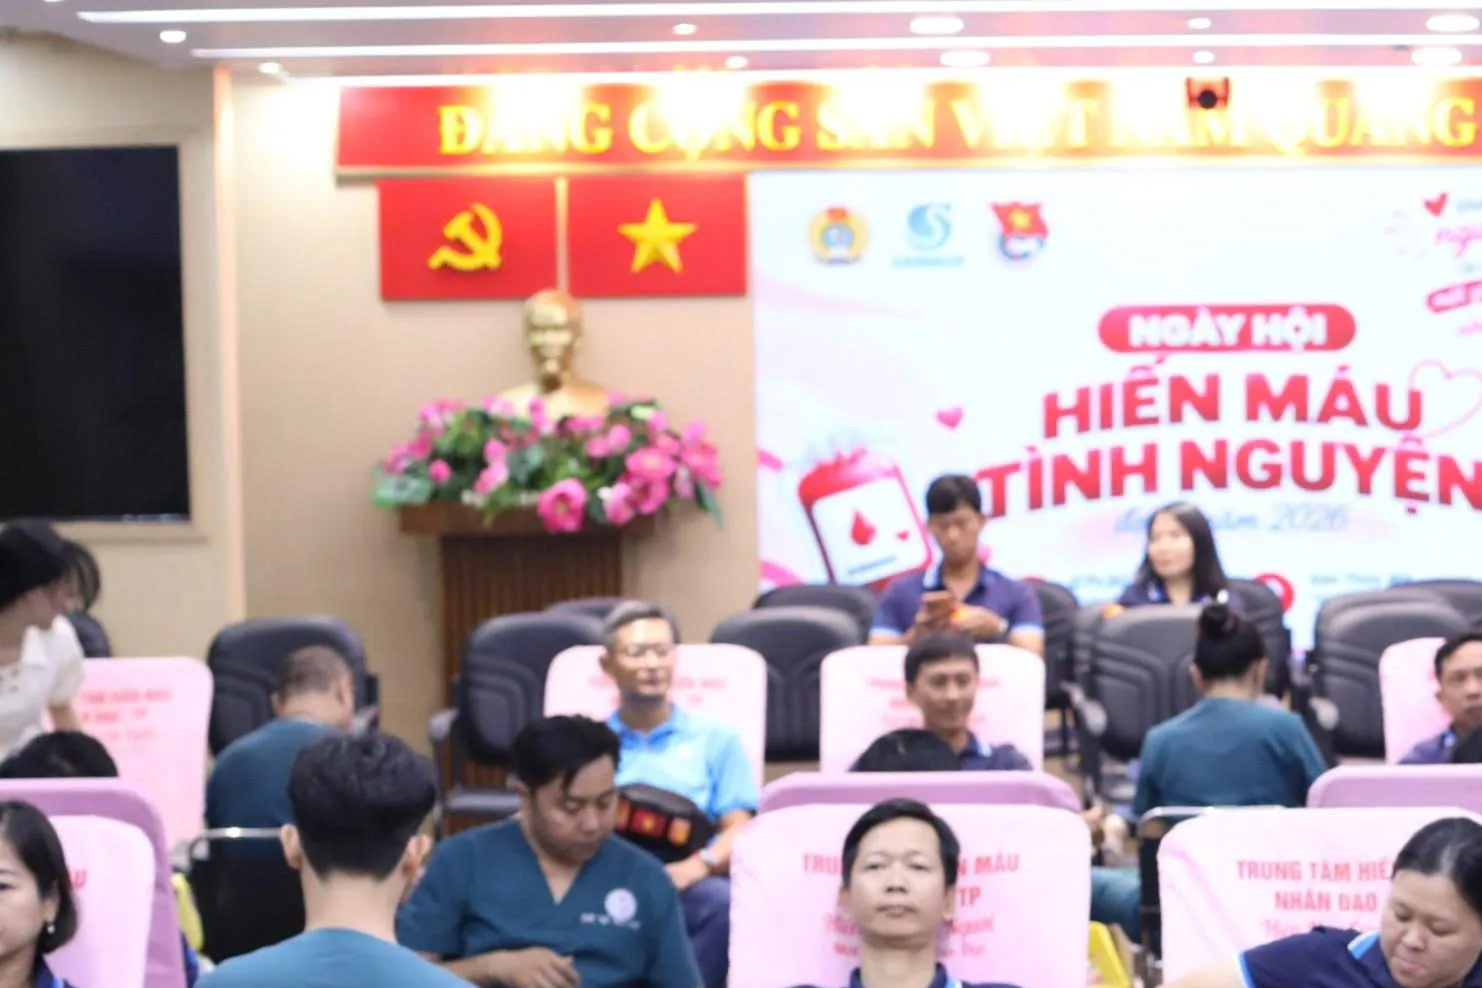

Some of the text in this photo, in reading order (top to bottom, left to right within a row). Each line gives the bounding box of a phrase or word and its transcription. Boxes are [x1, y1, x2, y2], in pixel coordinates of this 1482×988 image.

[438, 102, 613, 155] ĐG
[627, 98, 800, 163] CNG
[816, 100, 936, 150] SN
[948, 99, 1099, 157] VT
[1129, 304, 1328, 354] NGÀY HỘI
[1043, 354, 1423, 439] HIẾN MÁU
[976, 446, 1159, 519] TÌNH
[803, 854, 843, 875] TRU
[1358, 856, 1394, 881] HIẾ
